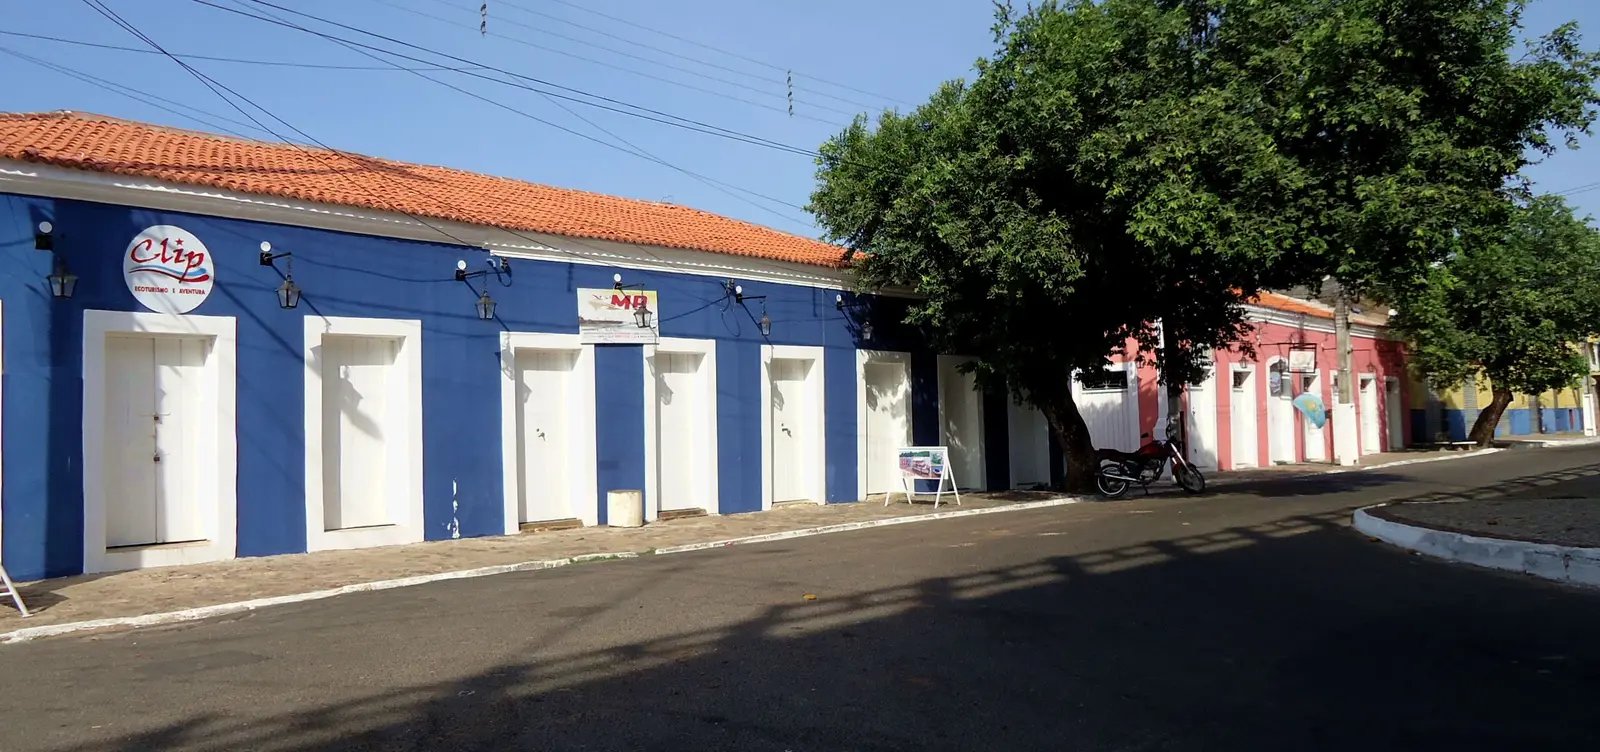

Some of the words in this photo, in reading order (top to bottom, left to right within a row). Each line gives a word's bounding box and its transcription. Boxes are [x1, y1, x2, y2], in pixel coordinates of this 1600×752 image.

[130, 237, 205, 284] Clip
[134, 285, 169, 294] ECOTURISMO
[178, 287, 206, 295] AVENTURA
